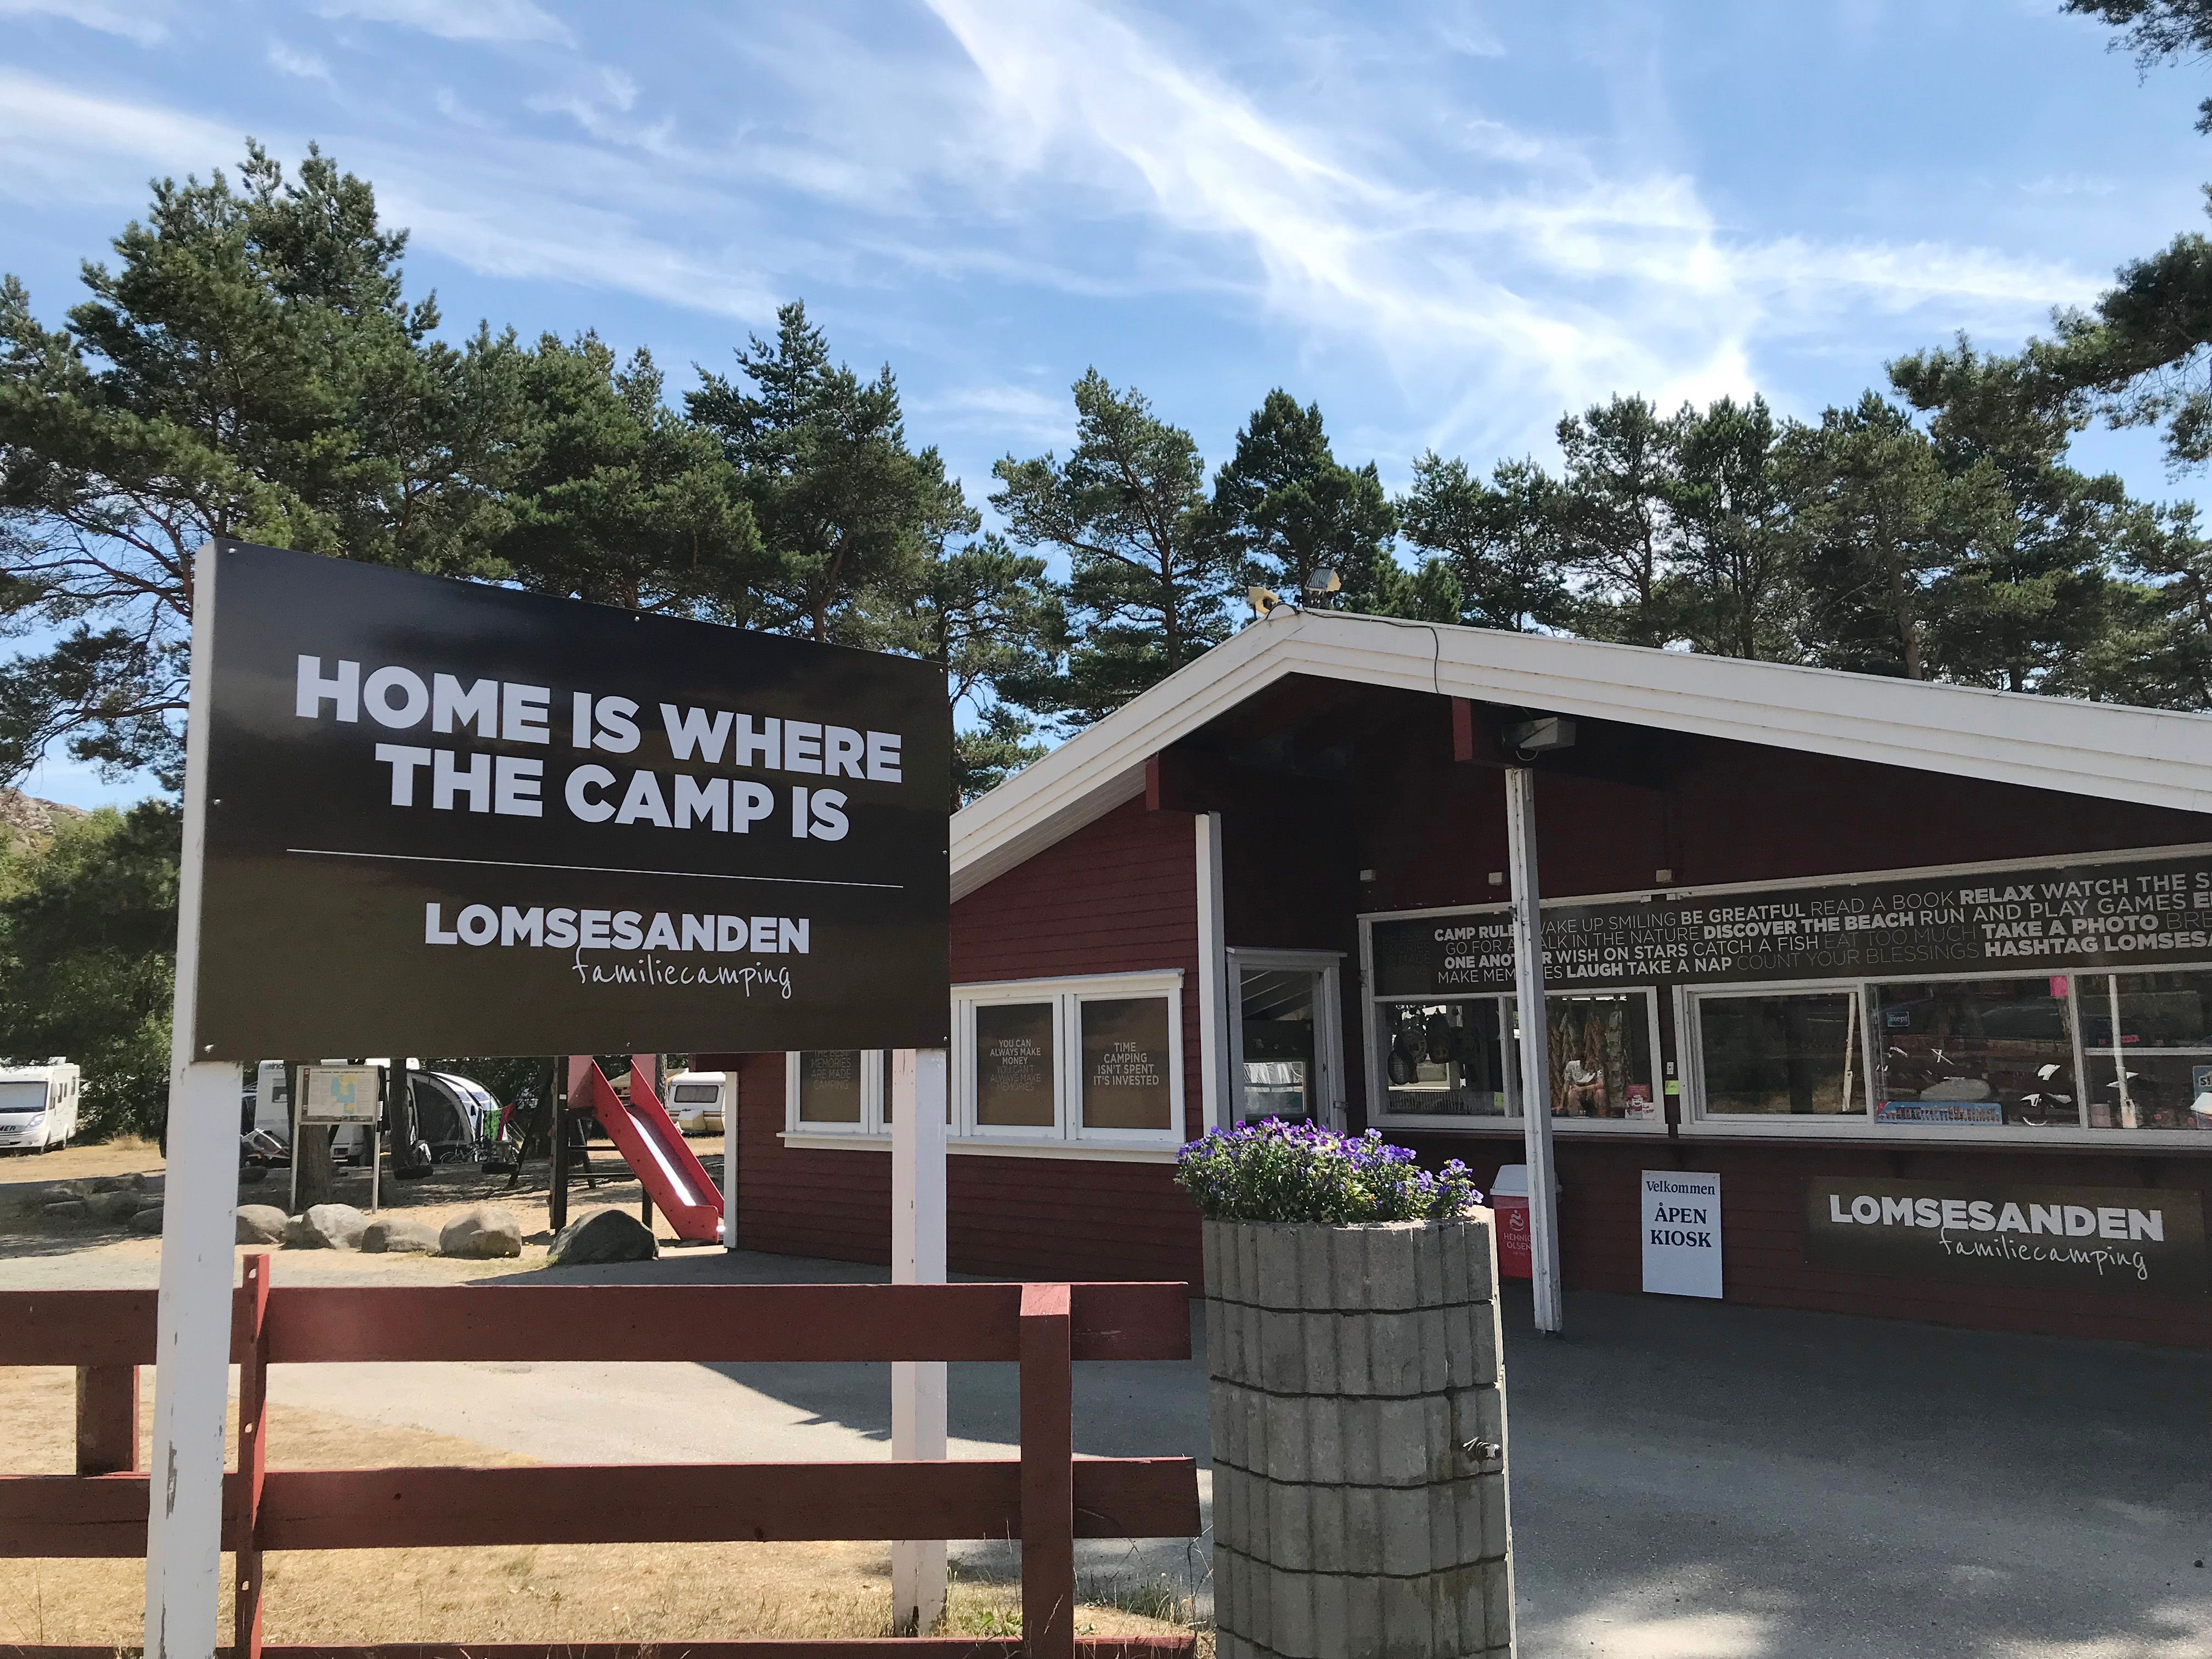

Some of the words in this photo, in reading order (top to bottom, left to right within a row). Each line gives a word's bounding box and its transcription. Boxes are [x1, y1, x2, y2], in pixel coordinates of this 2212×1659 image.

[297, 654, 551, 744] HOME
[572, 691, 640, 754] IS
[659, 703, 902, 784] WHERE
[375, 743, 543, 817] THE
[565, 764, 774, 834] CAMP
[792, 786, 849, 842] IS
[1434, 927, 1476, 941] CAMP
[1582, 917, 1604, 932] UP
[1609, 912, 1676, 930] SMILING
[1681, 910, 1703, 926] BE
[1709, 903, 1805, 923] GREATFUL
[1811, 898, 1864, 916] READ
[1872, 896, 1886, 912] A
[1893, 890, 1955, 910] BOOK
[1959, 884, 2036, 905] RELAX
[2040, 878, 2129, 900] WATCH
[2136, 873, 2187, 893] THE
[426, 902, 810, 954] LOMSESANDEN
[1446, 942, 1468, 956] GO
[1472, 939, 1502, 954] FOR
[1573, 934, 1587, 948] IN
[1593, 931, 1624, 947] THE
[1630, 926, 1700, 944] NATURE
[1704, 919, 1798, 940] DISCOVER
[1801, 917, 1841, 933] THE
[1844, 911, 1915, 931] BEACH
[1920, 907, 1965, 926] RUN
[1972, 904, 2022, 922] AND
[2030, 899, 2089, 919] PLAY
[2097, 893, 2186, 915] GAMES
[1444, 956, 1476, 969] ONE
[1555, 948, 1598, 964] WISH
[1604, 946, 1629, 962] ON
[1634, 943, 1688, 960] STARS
[1693, 939, 1752, 956] CATCH
[1758, 938, 1772, 953] A
[1778, 935, 1818, 951] FISH
[1824, 932, 1859, 949] EAT
[1865, 929, 1907, 946] TOO
[1914, 925, 1976, 944] MUCH
[1981, 920, 2042, 939] TAKE
[2049, 919, 2067, 935] A
[2072, 914, 2159, 934] PHOTO
[1437, 970, 1479, 984] MAKE
[1566, 962, 1623, 979] LAUGH
[1627, 960, 1671, 975] TAKE
[1677, 960, 1690, 973] A
[1695, 957, 1732, 972] NAP
[1737, 952, 1801, 970] COUNT
[1805, 949, 1860, 967] YOUR
[1866, 943, 1979, 964] BLESSINGS
[1985, 936, 2098, 957] HASHTAG
[2103, 930, 2212, 952] LOMSES
[572, 946, 792, 999] familiecamping
[998, 1039, 1014, 1048] YOU
[1015, 1039, 1031, 1047] CAN
[1114, 1042, 1136, 1052] TIME
[990, 1048, 1018, 1057] ALWAYS
[1020, 1047, 1041, 1056] MAKE
[1104, 1052, 1148, 1064] CAMPING
[811, 1057, 851, 1068] MEMORIES
[1002, 1057, 1028, 1065] MONEY
[828, 1068, 851, 1079] MADE
[996, 1065, 1012, 1074] YOU
[1098, 1064, 1121, 1075] ISN'T
[1124, 1064, 1154, 1074] SPENT
[990, 1074, 1019, 1082] ALWAYS
[1020, 1074, 1041, 1082] MAKE
[1093, 1075, 1110, 1086] IT'S
[1113, 1075, 1159, 1086] INVESTED
[996, 1082, 1034, 1091] MEMORIES
[1646, 1180, 1716, 1195] Velkommen
[1655, 1202, 1707, 1224] ÅPEN
[1830, 1194, 2164, 1242] LOMSESANDEN
[1650, 1229, 1712, 1248] KIOSK
[1506, 1241, 1532, 1250] OLSEN
[1939, 1226, 2147, 1280] familiecamping
